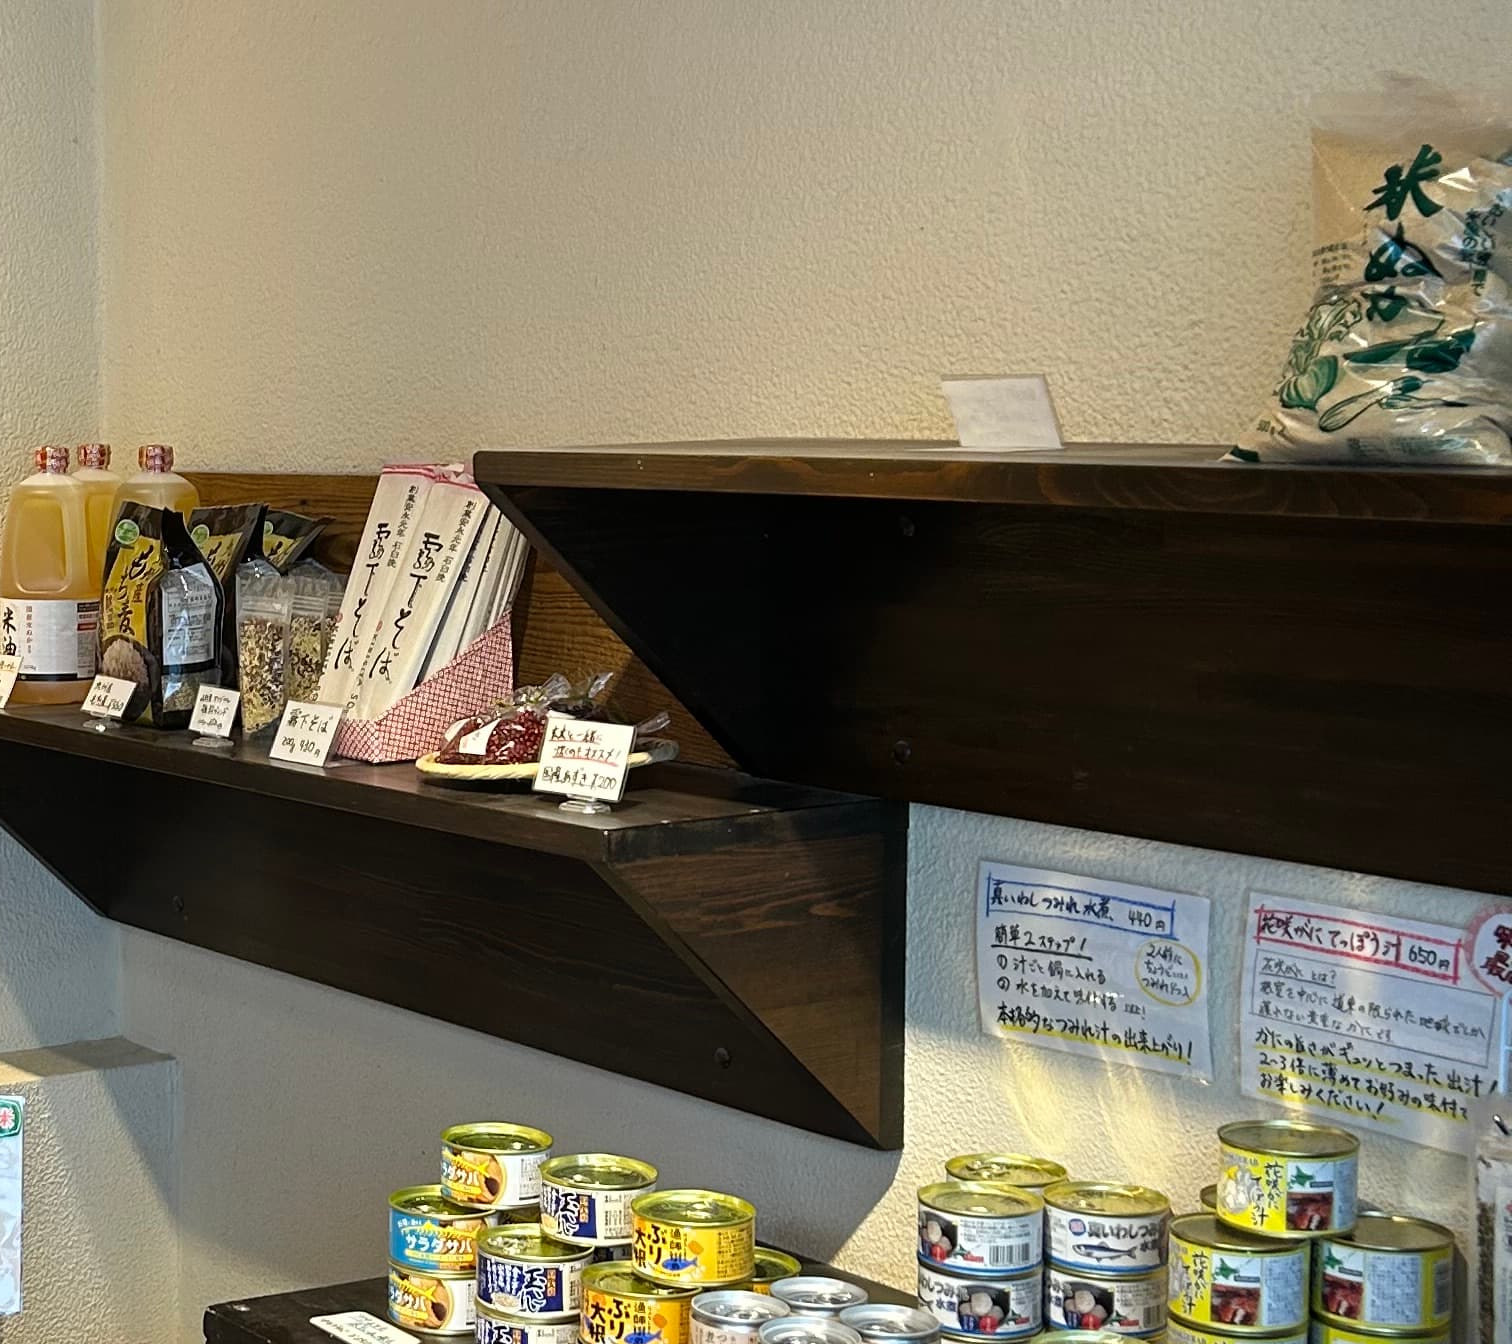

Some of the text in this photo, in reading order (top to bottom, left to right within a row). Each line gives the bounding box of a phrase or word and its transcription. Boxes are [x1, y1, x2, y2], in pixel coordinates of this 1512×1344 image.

[288, 708, 333, 734] 霧下そば
[1408, 945, 1450, 970] 650円
[648, 1225, 667, 1267] ぶり
[609, 1299, 630, 1339] ぶり
